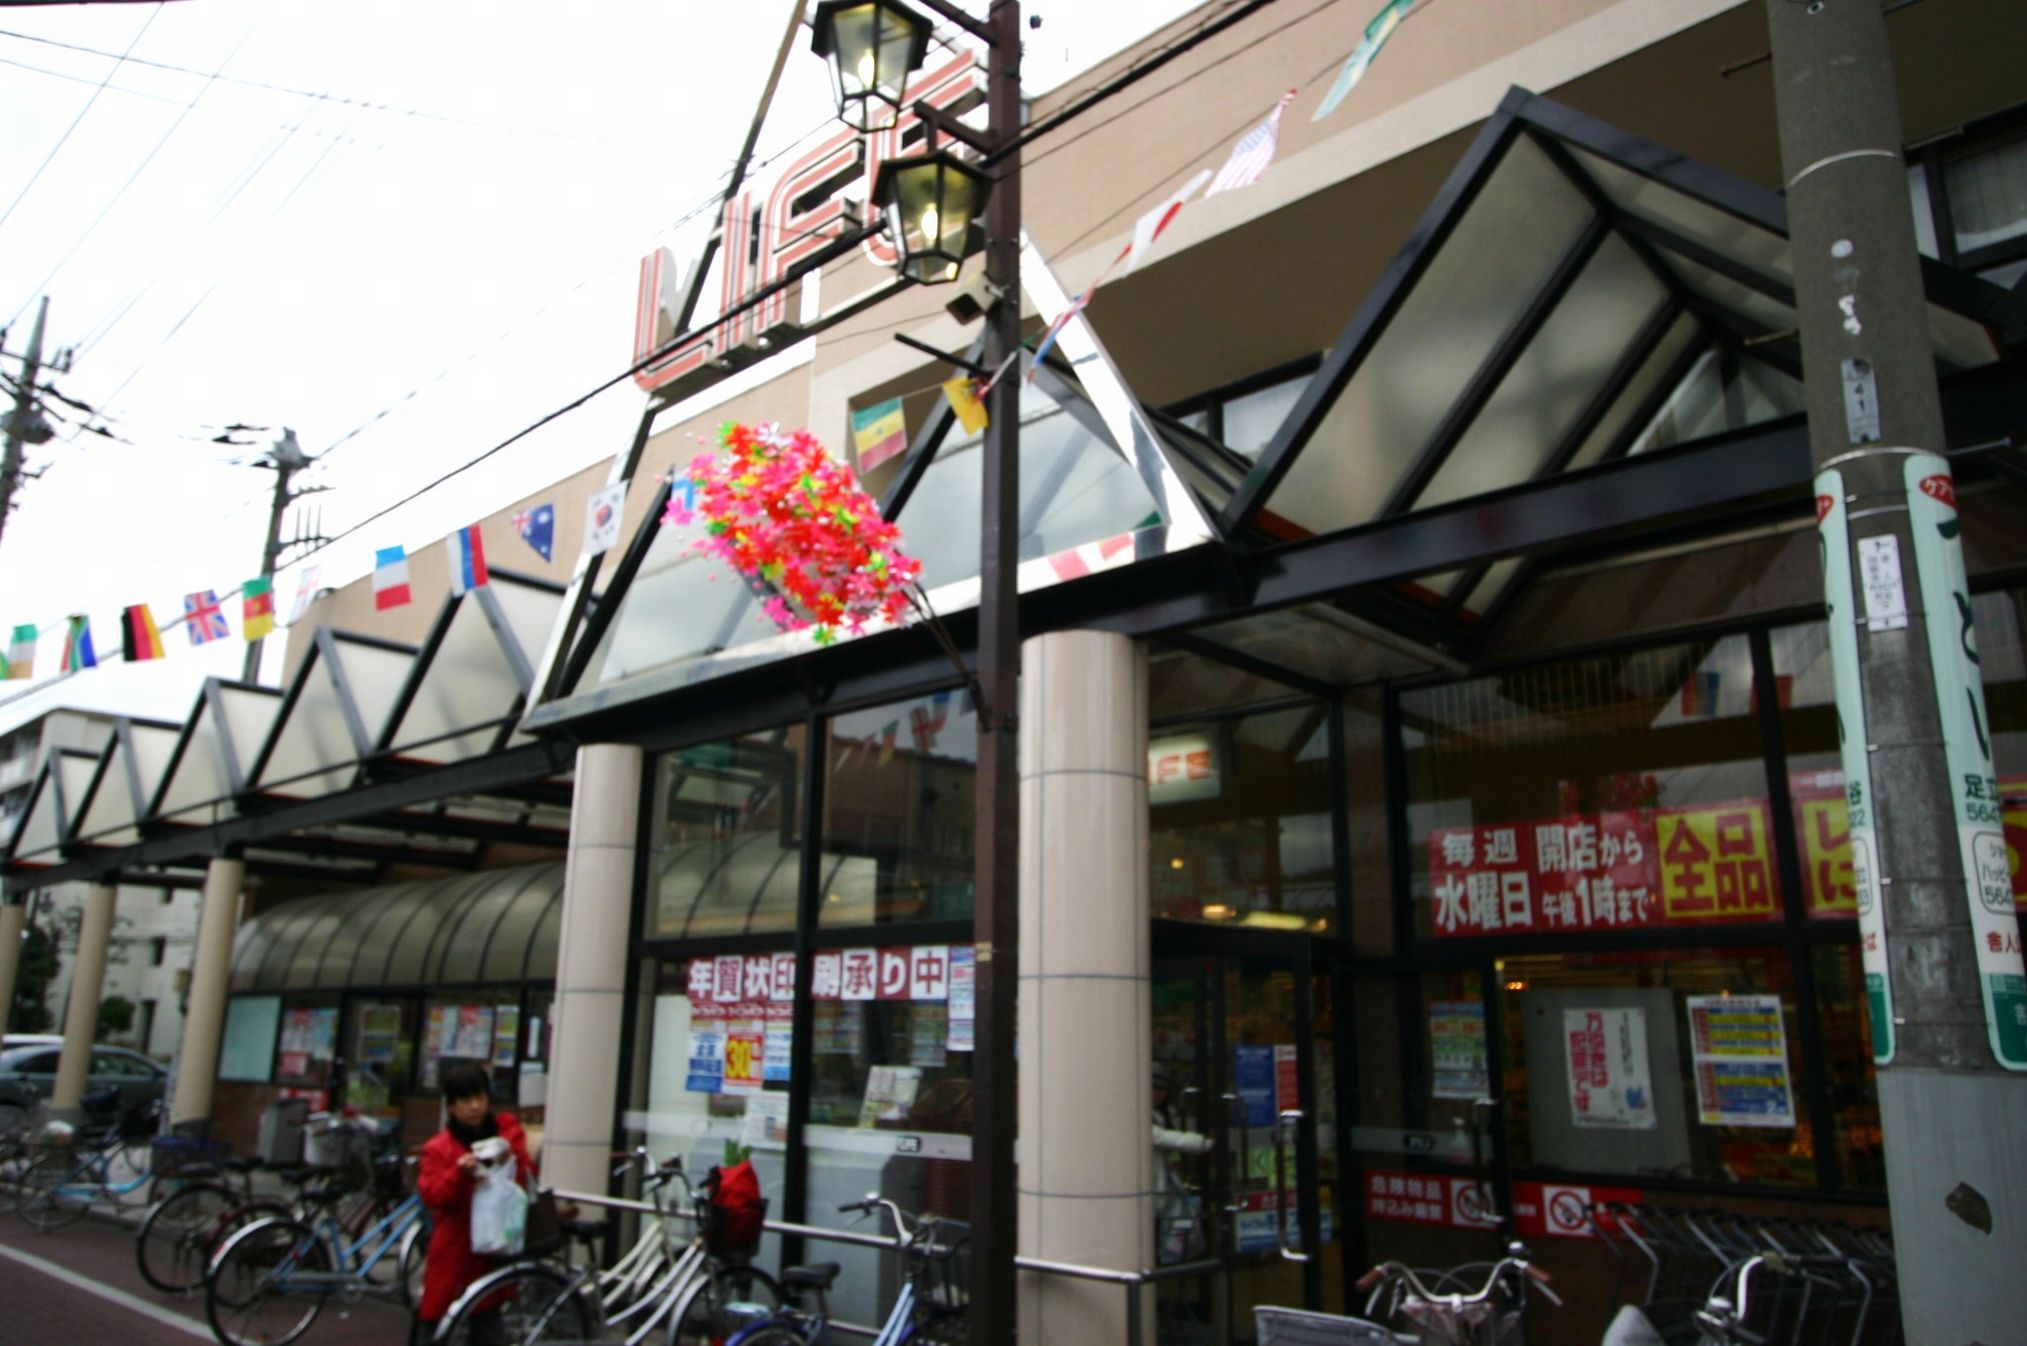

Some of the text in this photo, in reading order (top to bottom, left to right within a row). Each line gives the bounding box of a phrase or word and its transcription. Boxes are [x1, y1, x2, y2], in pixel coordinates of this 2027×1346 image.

[1443, 829, 1517, 866] 毎週
[1536, 822, 1643, 873] 開店から
[1665, 813, 1771, 911] 全品
[1435, 871, 1532, 932] 水曜日
[1542, 876, 1648, 926] 午後1時まで
